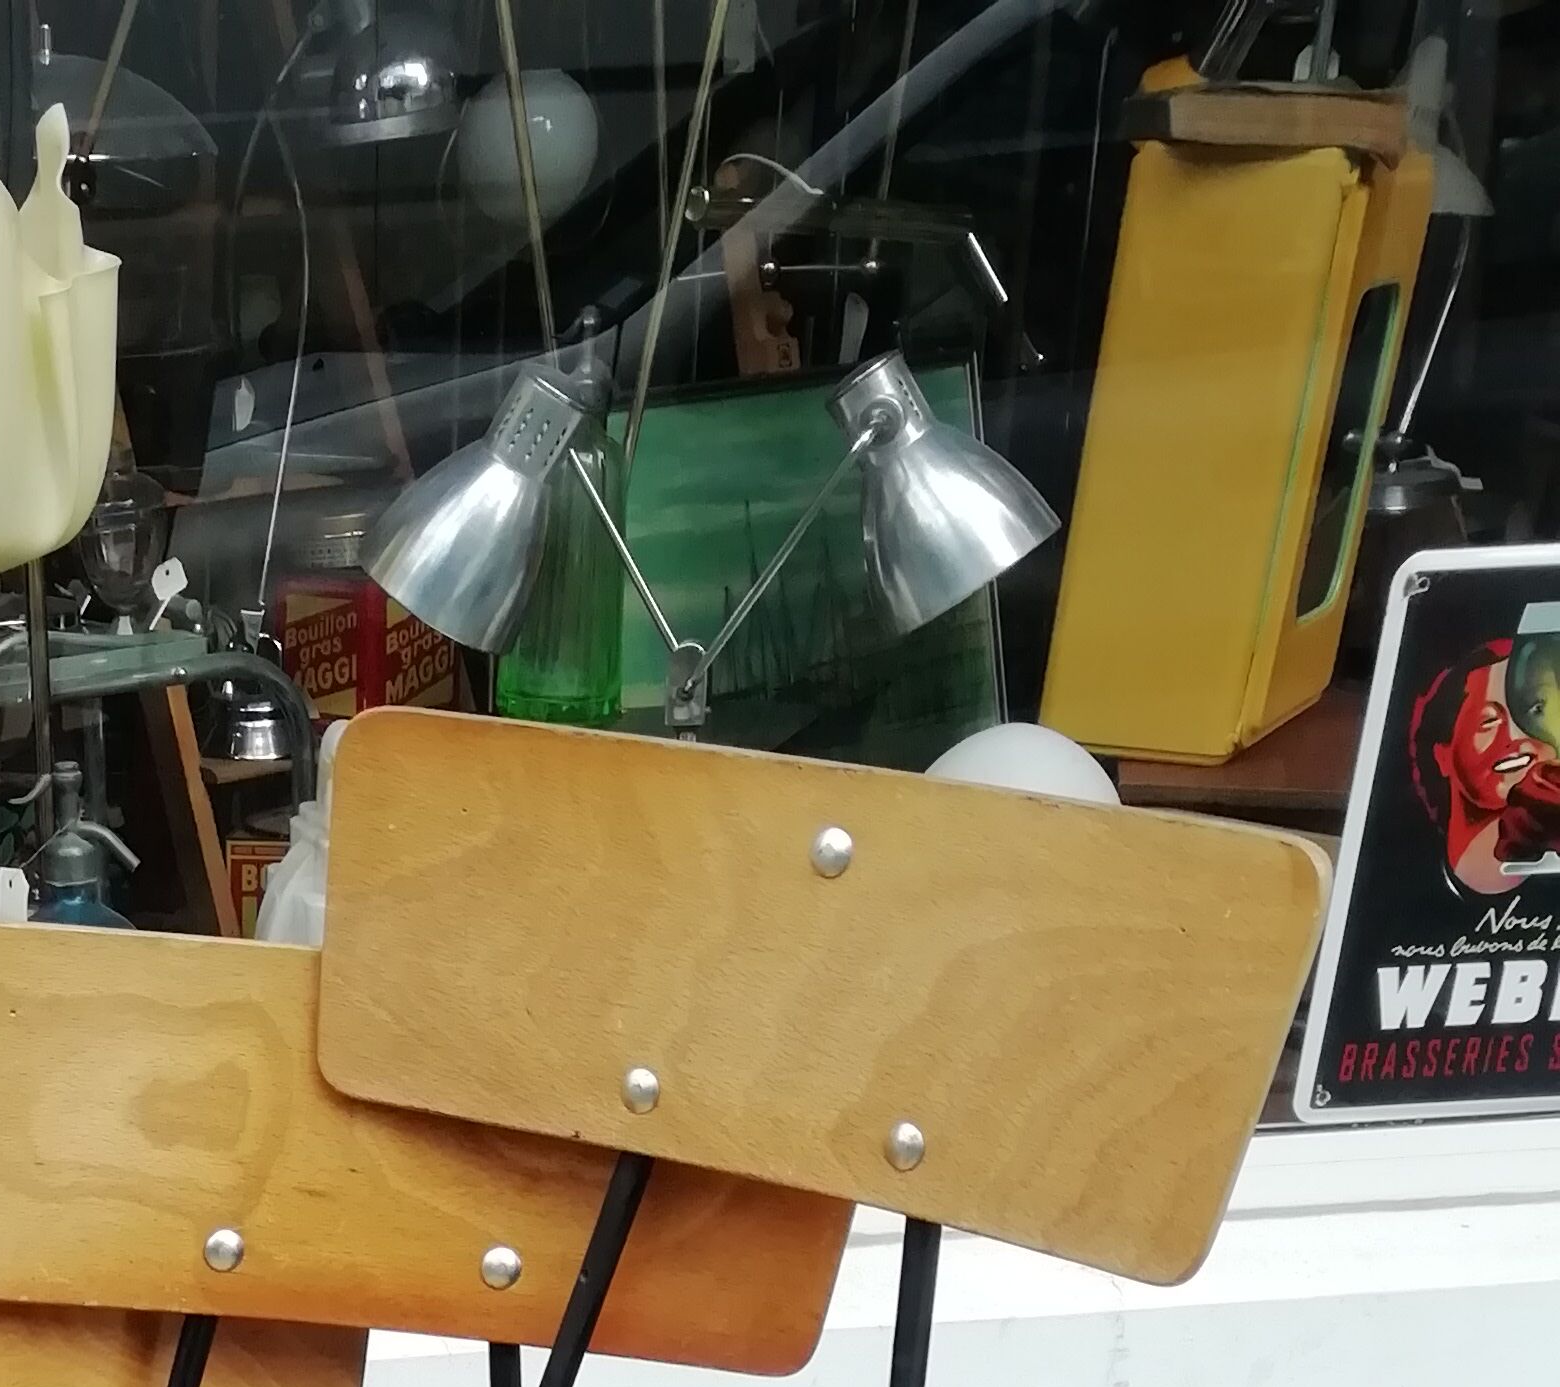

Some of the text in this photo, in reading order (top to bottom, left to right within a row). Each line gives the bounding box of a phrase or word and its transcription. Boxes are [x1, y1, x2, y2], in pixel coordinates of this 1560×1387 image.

[285, 611, 357, 650] Bouillon
[300, 636, 342, 670] gras
[385, 640, 455, 705] MAGGI
[1475, 895, 1553, 934] Nous
[1391, 944, 1445, 957] nous
[1527, 932, 1548, 951] de
[1338, 1032, 1535, 1082] BRASSERIES
